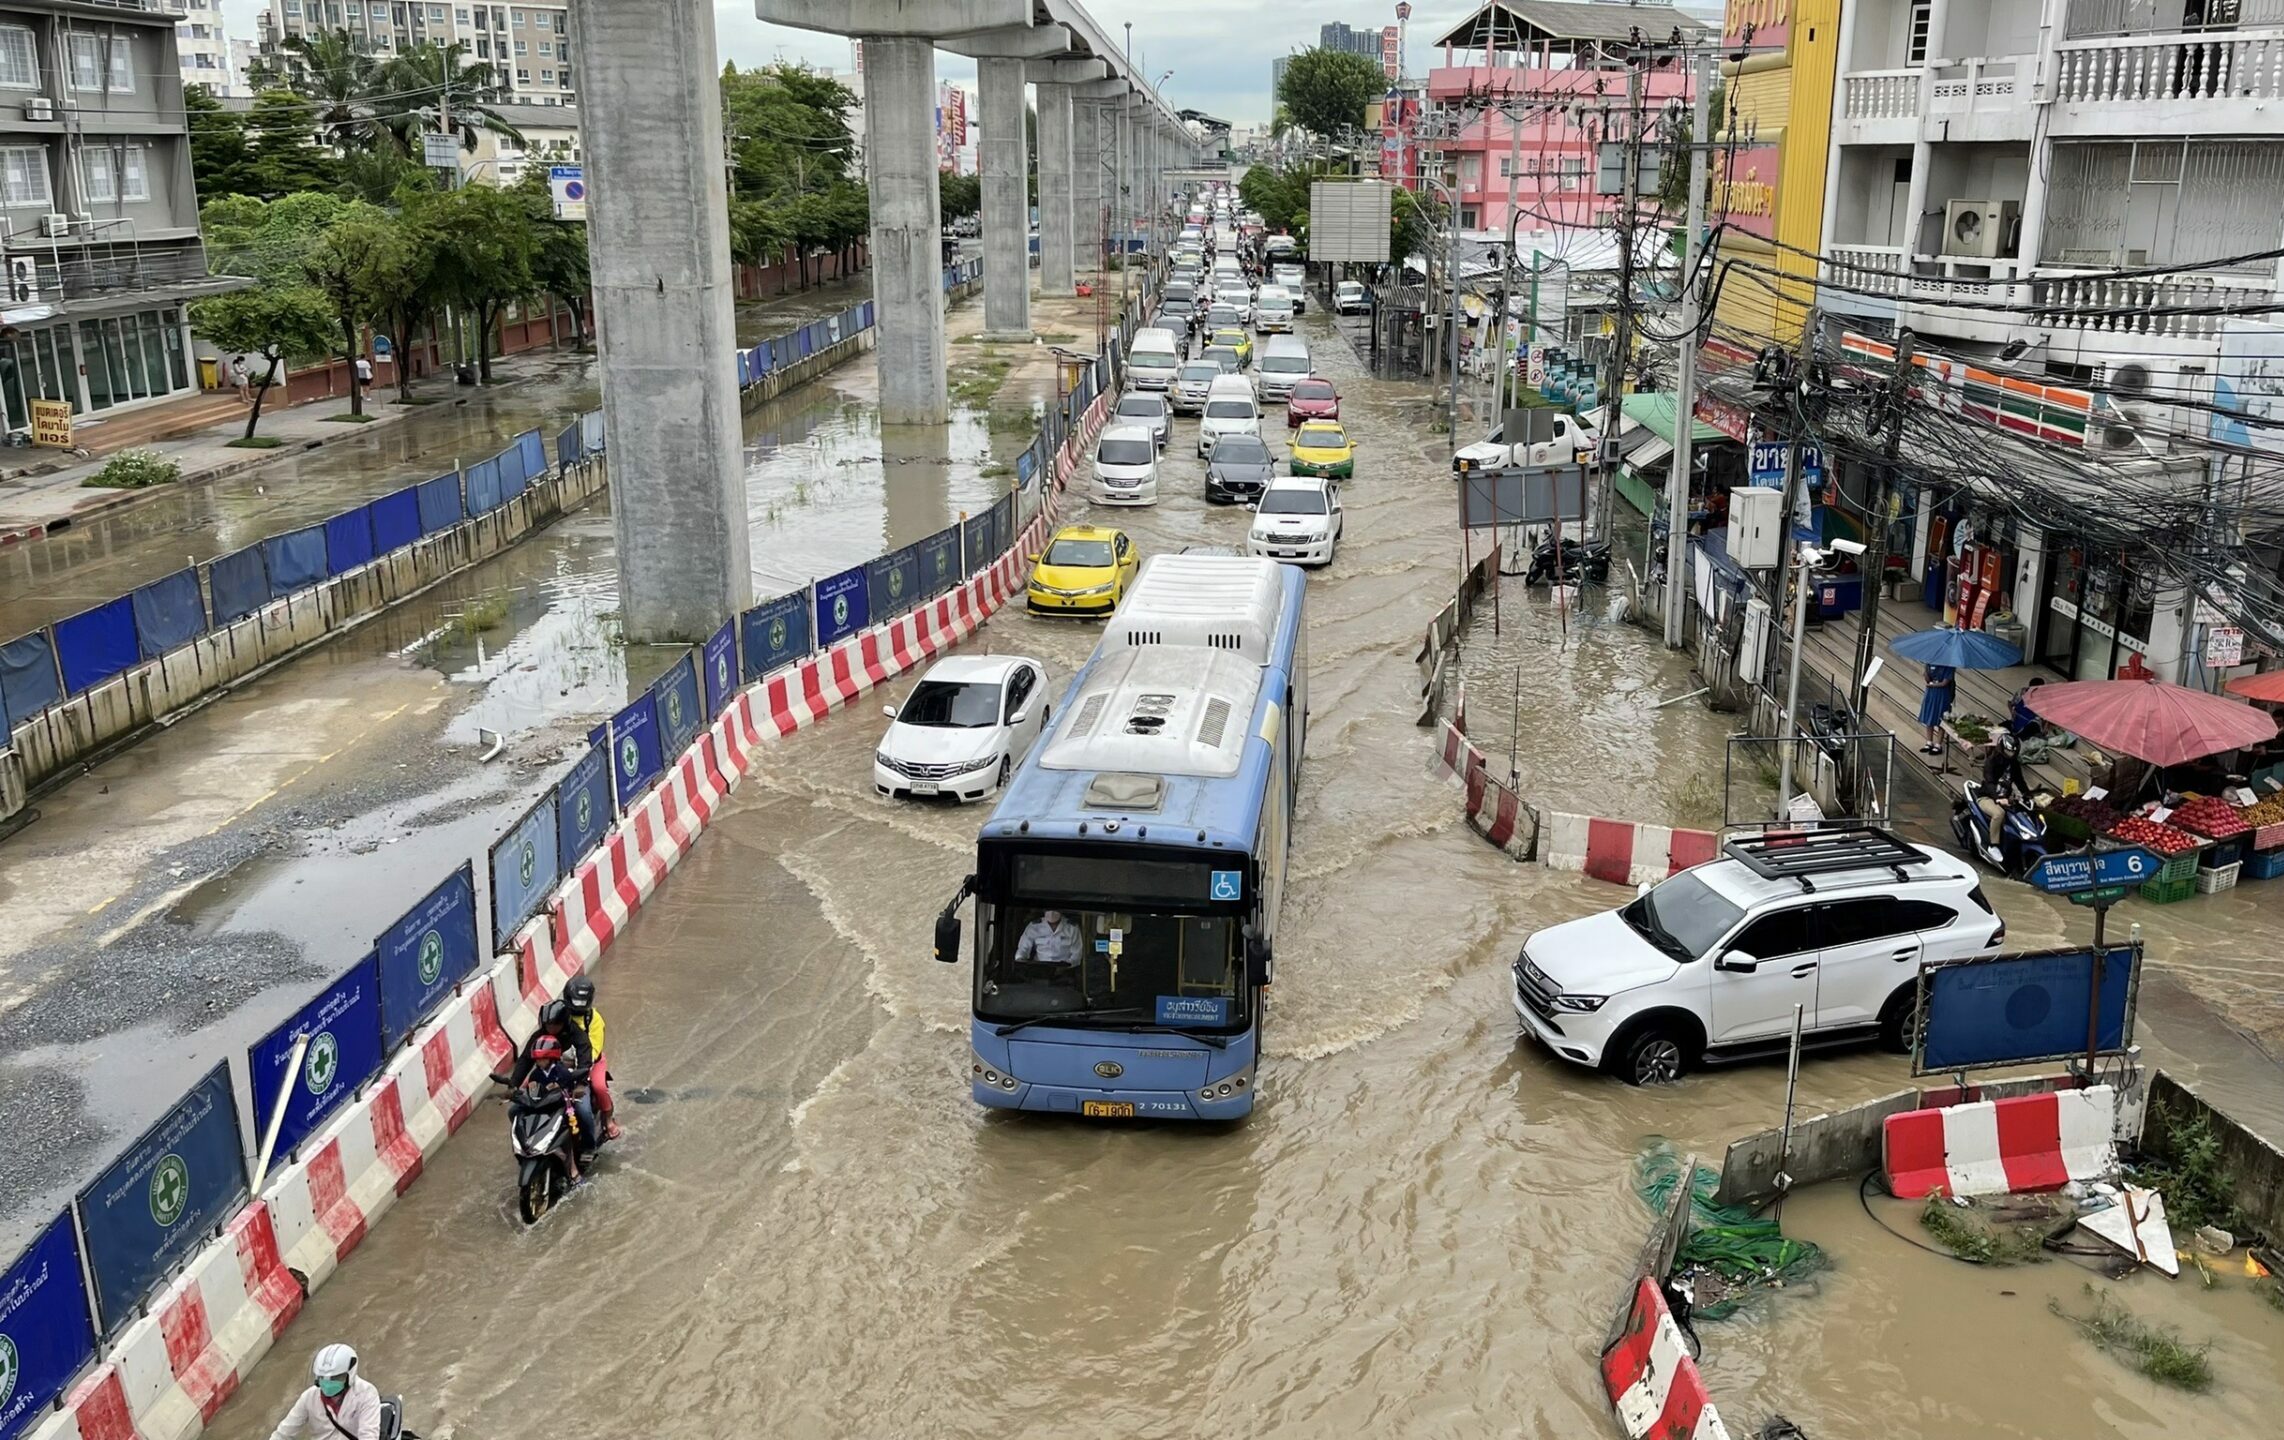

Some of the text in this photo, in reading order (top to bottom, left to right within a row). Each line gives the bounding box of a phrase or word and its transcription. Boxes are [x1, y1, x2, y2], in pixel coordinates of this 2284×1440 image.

[40, 432, 70, 444] แอร์
[2127, 855, 2143, 873] 6
[1139, 1102, 1188, 1111] 2 70131
[174, 1184, 187, 1211] FIRST
